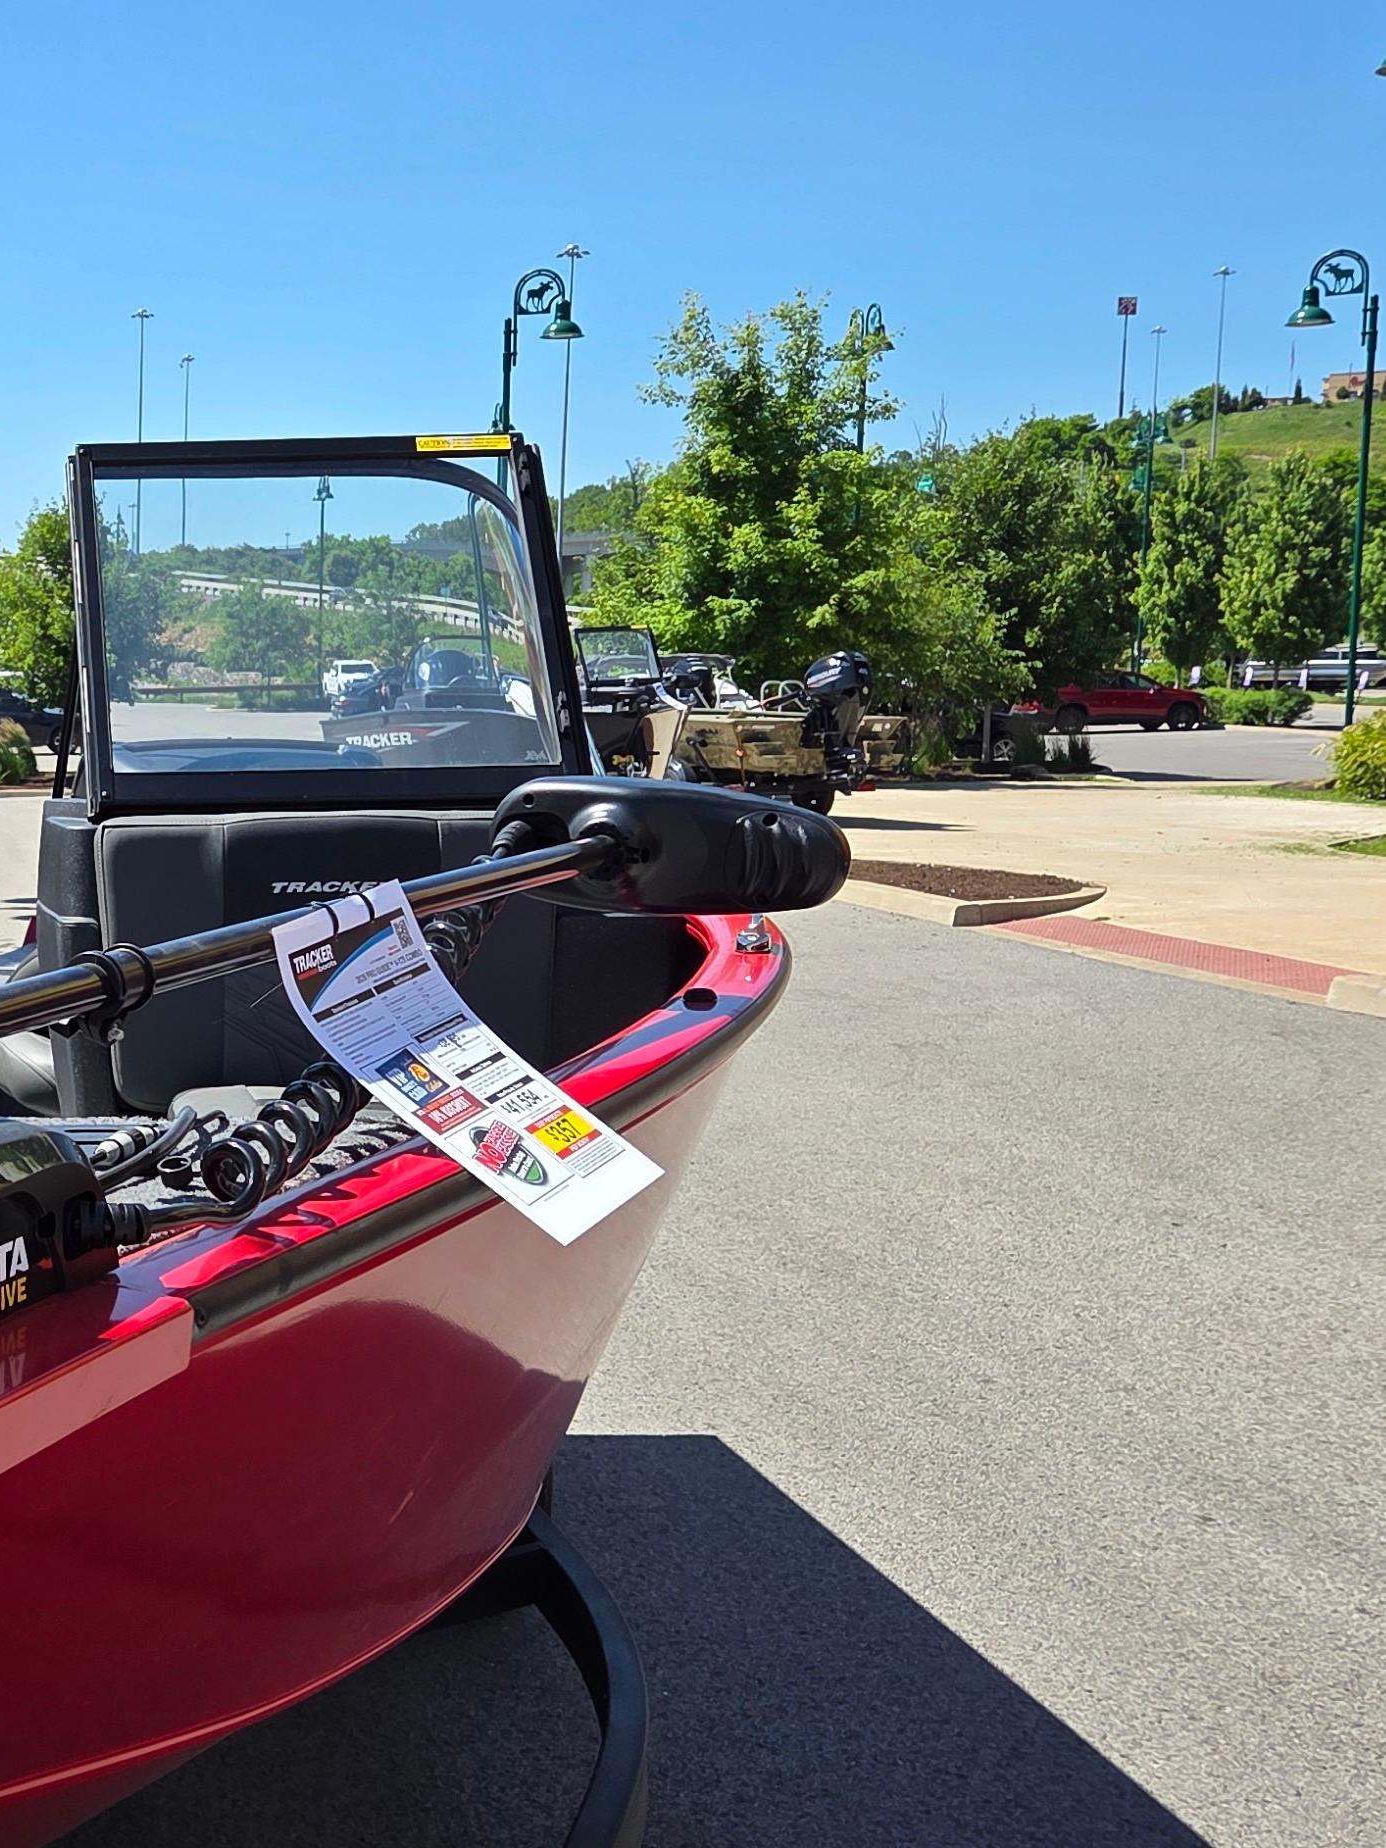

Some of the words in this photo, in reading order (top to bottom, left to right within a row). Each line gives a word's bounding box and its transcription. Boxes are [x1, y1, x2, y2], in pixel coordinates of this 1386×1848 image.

[345, 731, 413, 748] TRACKER
[271, 881, 385, 894] TRACKE
[293, 943, 334, 974] TRACKER
[317, 959, 337, 973] boats
[500, 1089, 542, 1114] $41,554
[545, 1118, 582, 1143] $357
[473, 1143, 508, 1174] NO
